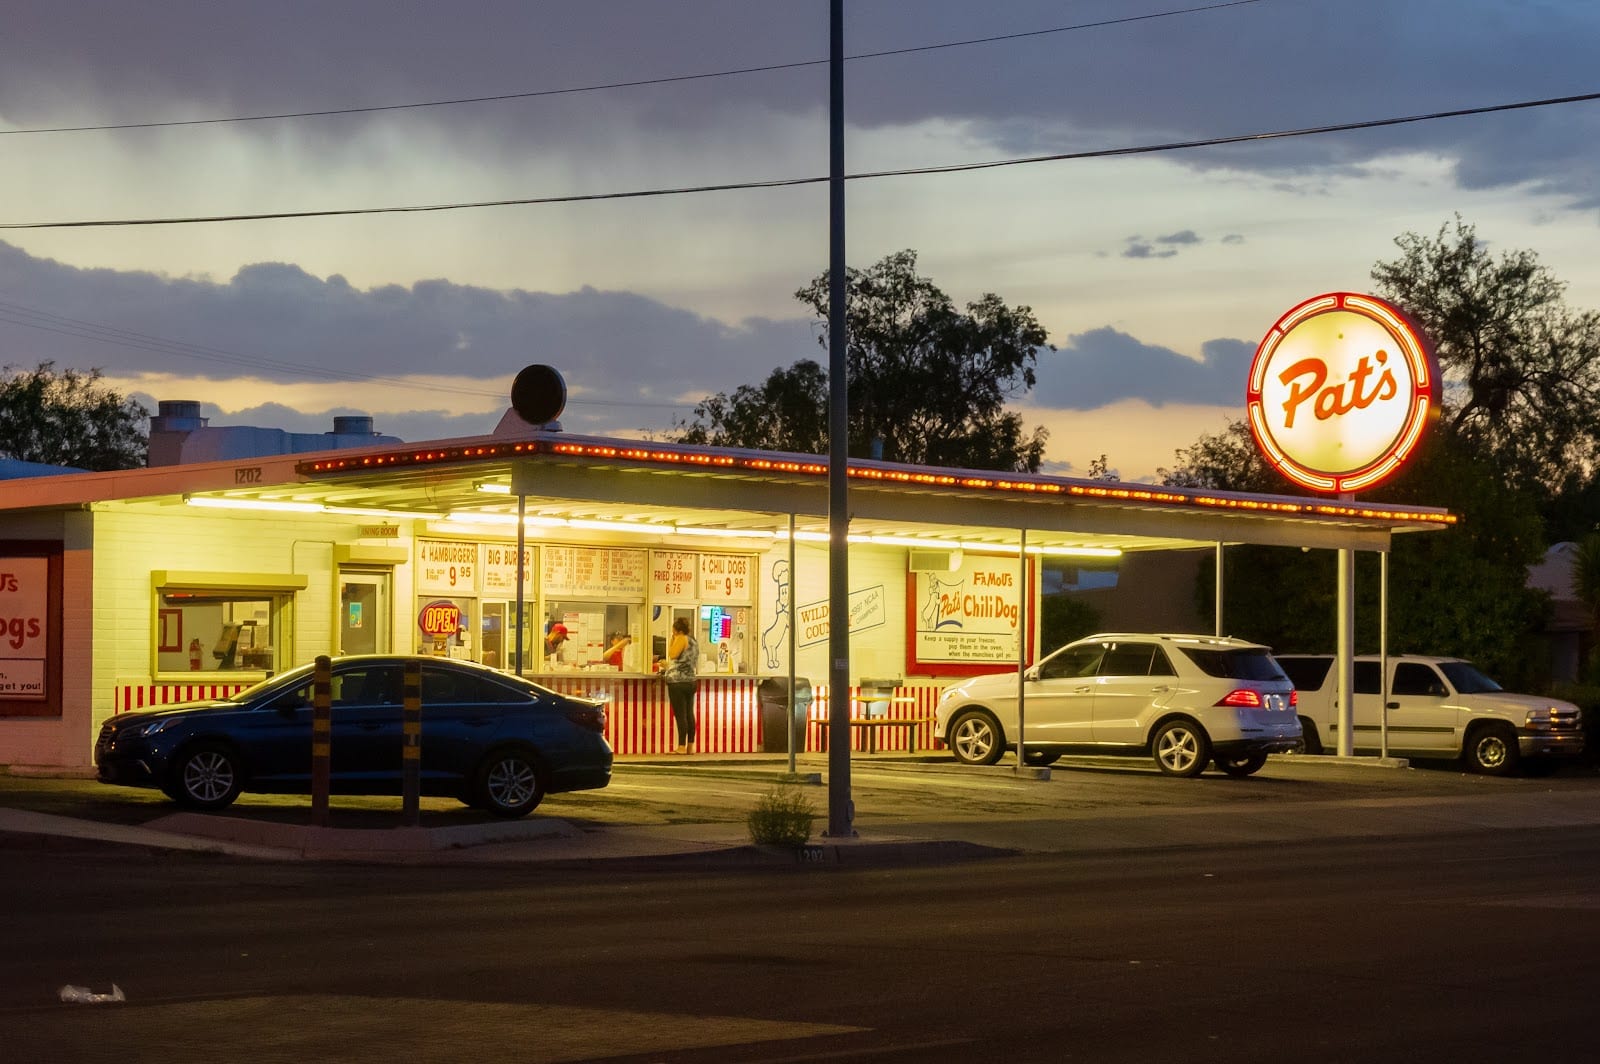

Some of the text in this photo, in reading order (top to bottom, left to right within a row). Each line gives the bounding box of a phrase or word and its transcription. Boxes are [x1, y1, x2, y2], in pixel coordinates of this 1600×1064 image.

[1278, 350, 1398, 429] Pat's
[235, 467, 262, 484] 1202
[380, 528, 398, 536] ROOM
[421, 546, 475, 564] 4 HAMBURGERS
[488, 549, 500, 565] BIG
[504, 550, 530, 566] BURER
[666, 560, 682, 570] 6.75
[708, 559, 724, 574] CHILI
[728, 560, 746, 575] DOGS
[449, 566, 471, 586] 9 95
[654, 570, 692, 582] FRIED SHRIMP
[665, 584, 681, 594] 6.75
[725, 577, 744, 595] 9 95
[940, 591, 960, 618] Pat's
[963, 594, 992, 618] Chili
[425, 608, 458, 632] OPEN
[801, 605, 829, 624] WILD
[20, 683, 41, 691] you!
